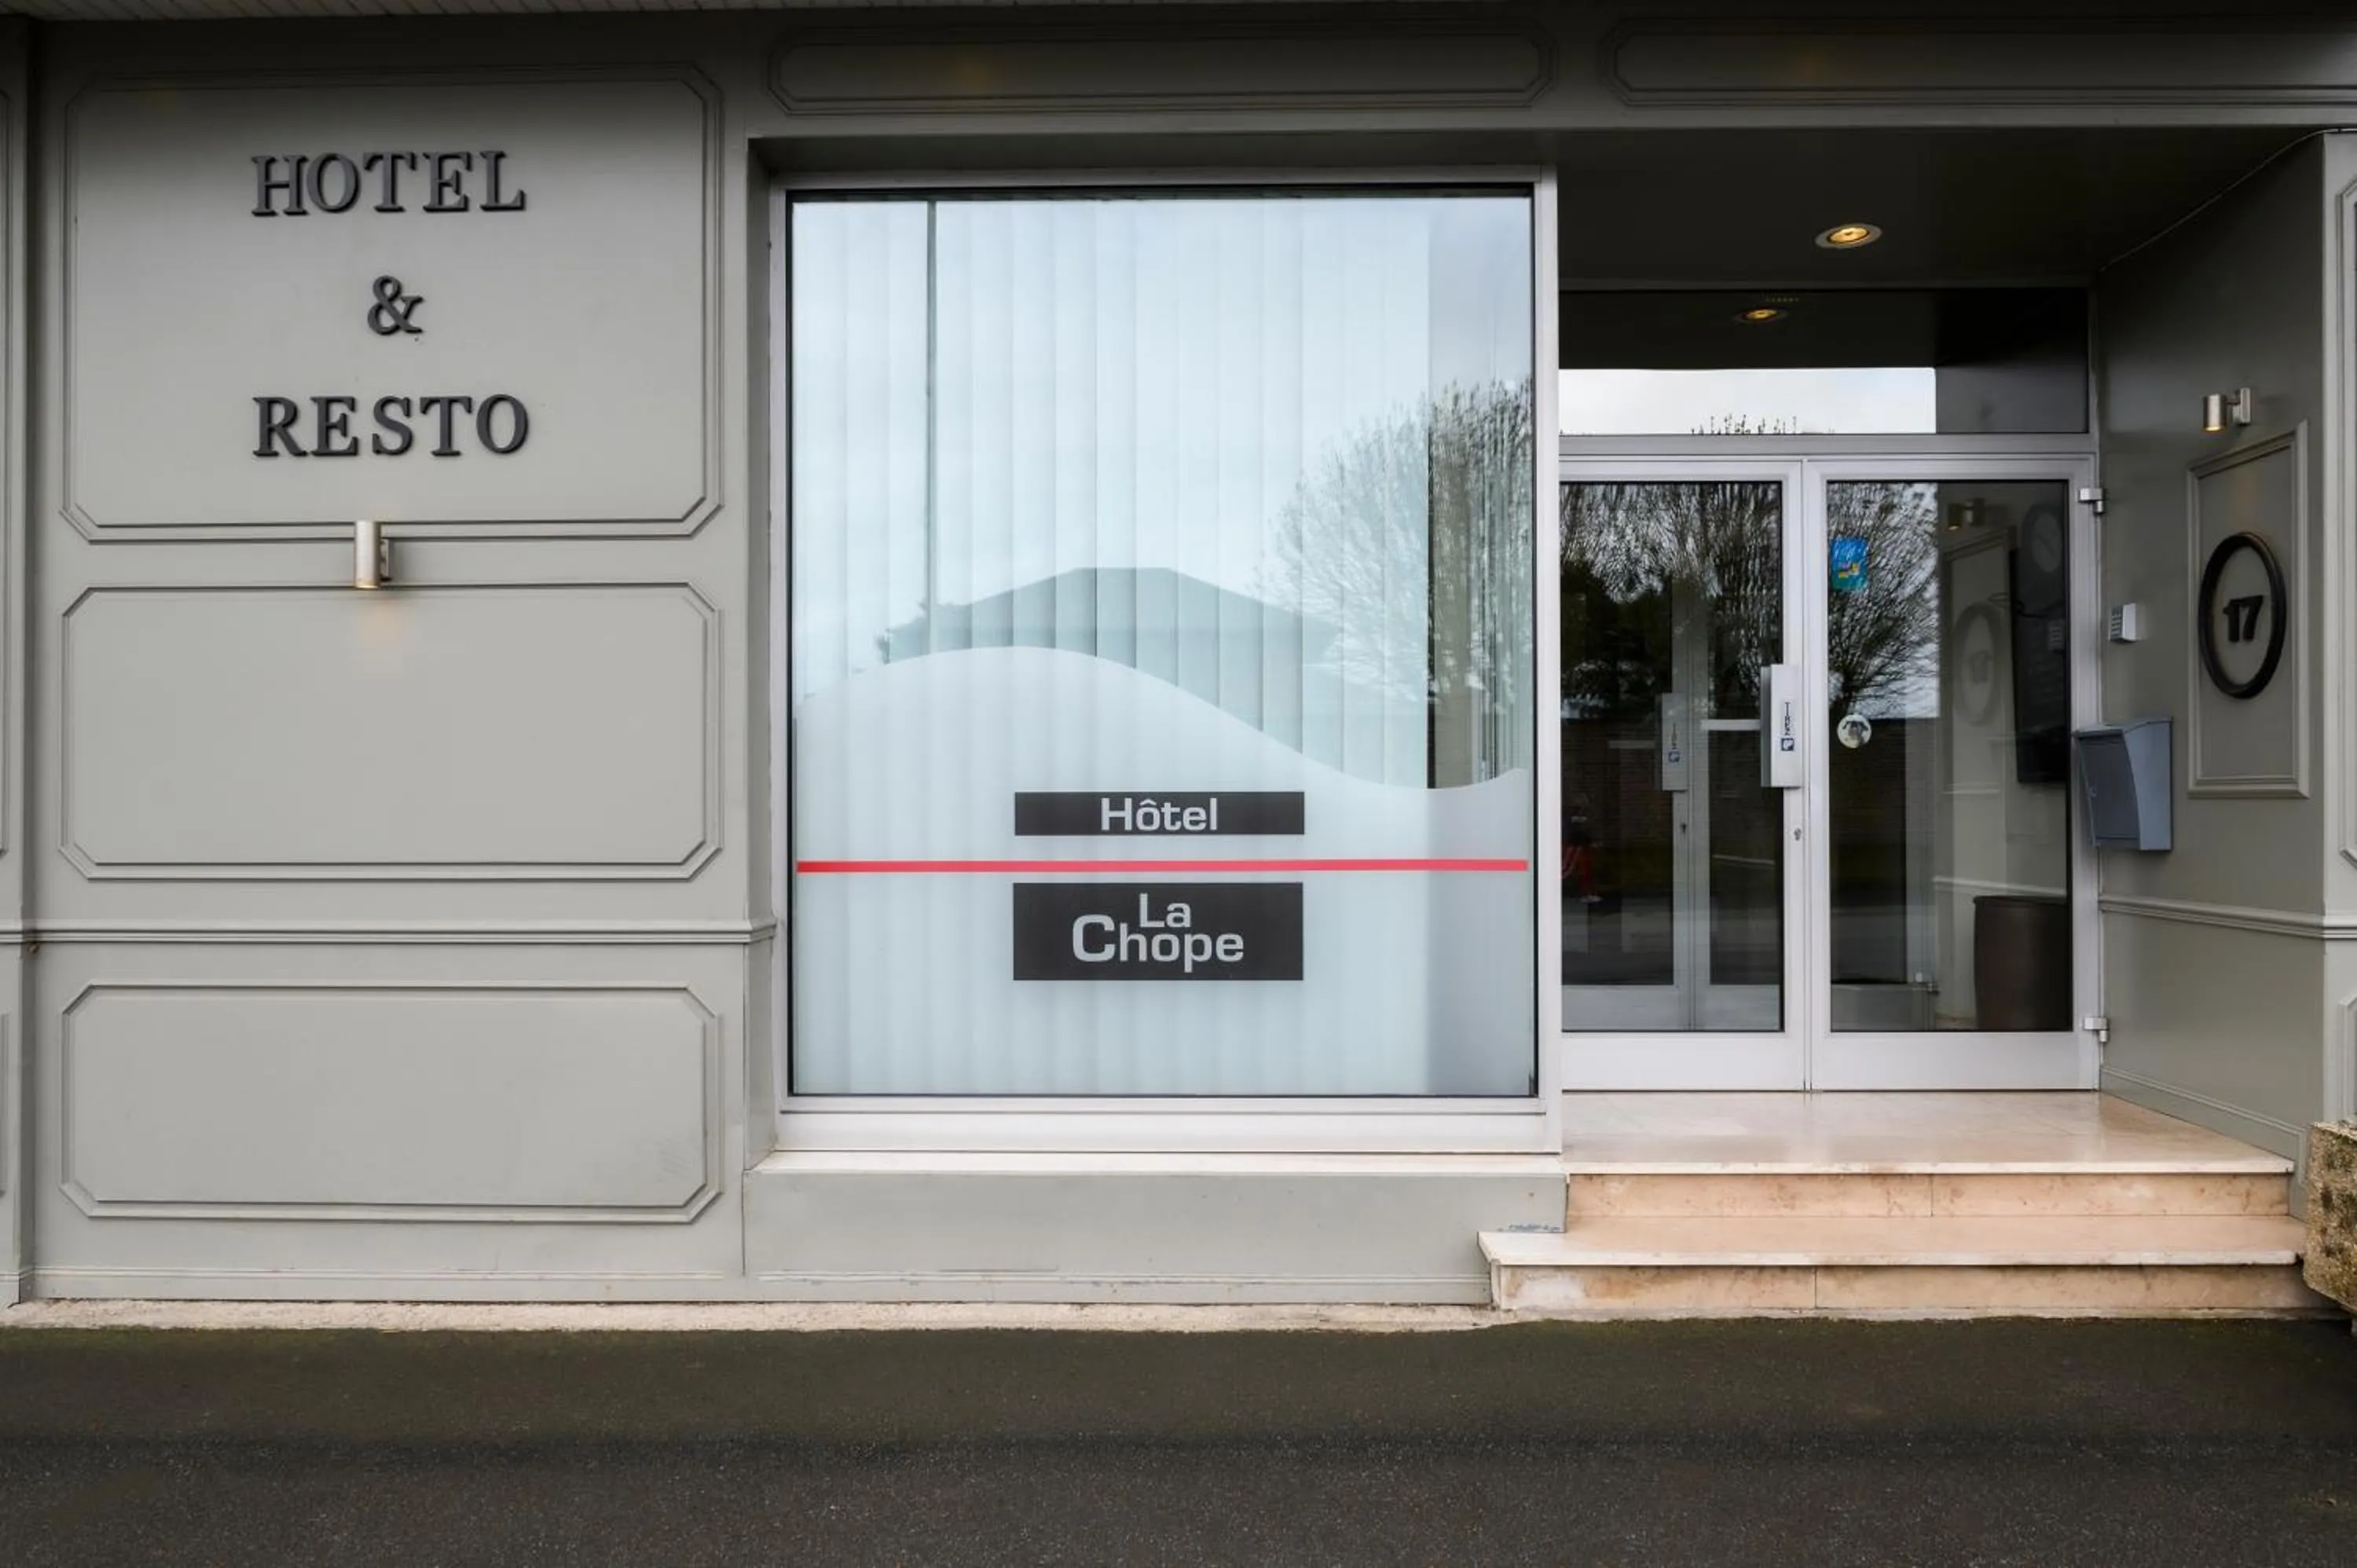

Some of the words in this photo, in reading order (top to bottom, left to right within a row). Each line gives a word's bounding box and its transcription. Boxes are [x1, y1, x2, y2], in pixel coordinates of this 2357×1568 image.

[251, 150, 526, 217] HOTEL
[367, 275, 424, 335] &
[251, 394, 530, 457] RESTO
[2222, 595, 2264, 643] 17
[1101, 797, 1218, 831] Hôtel
[1139, 892, 1192, 928] La
[1072, 914, 1244, 973] Chope
